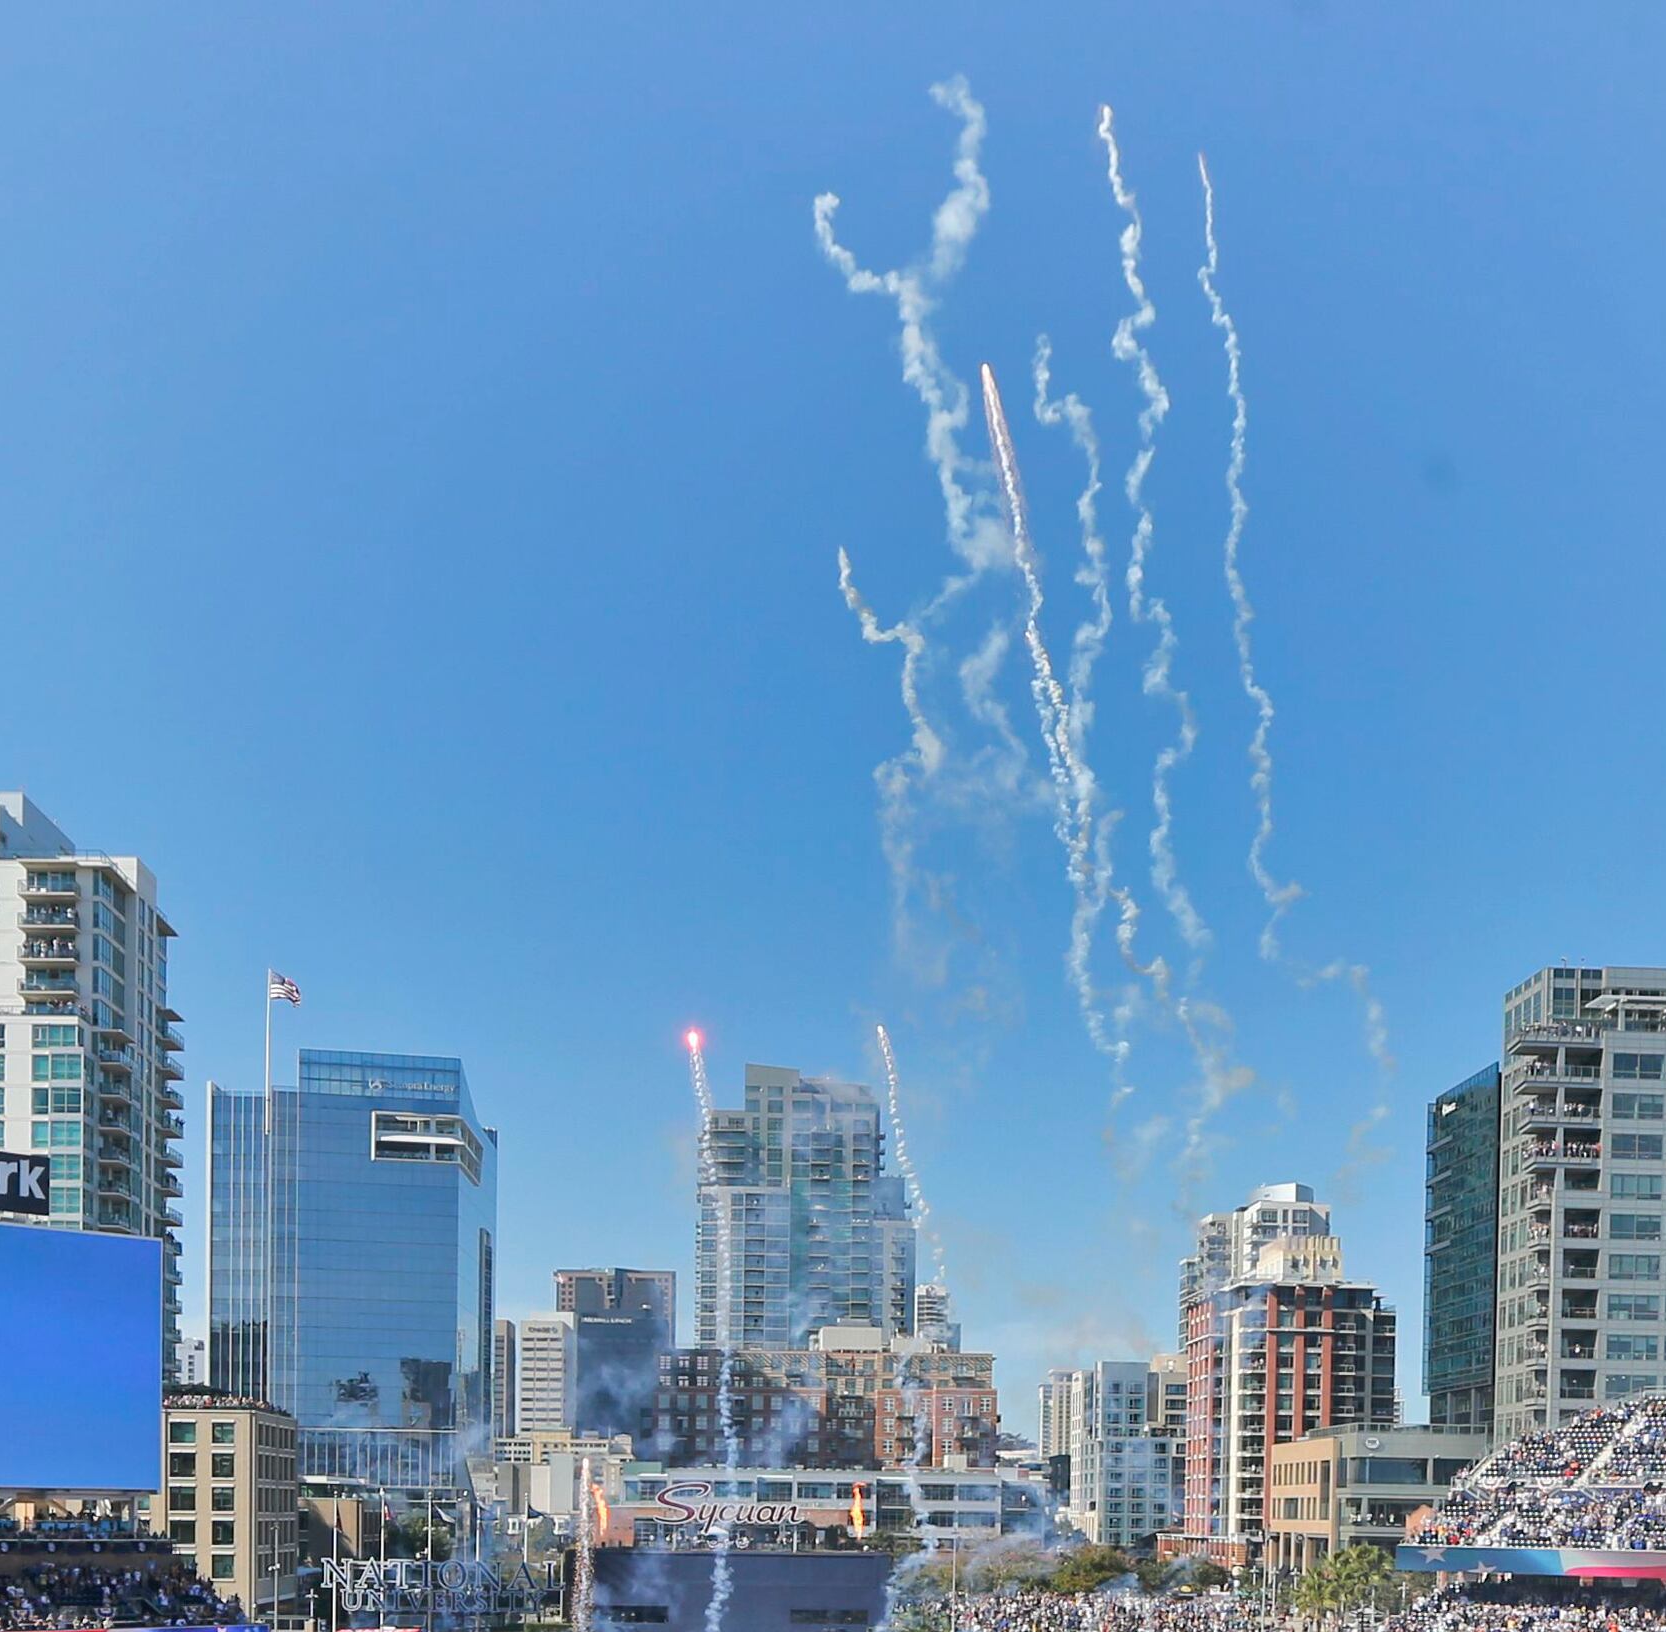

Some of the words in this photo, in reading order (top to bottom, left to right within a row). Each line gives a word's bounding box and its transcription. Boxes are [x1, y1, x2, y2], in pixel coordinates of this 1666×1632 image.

[653, 1481, 806, 1535] Sycuan
[320, 1556, 566, 1591] NATIONAL
[340, 1588, 548, 1613] UNIVERSITY
